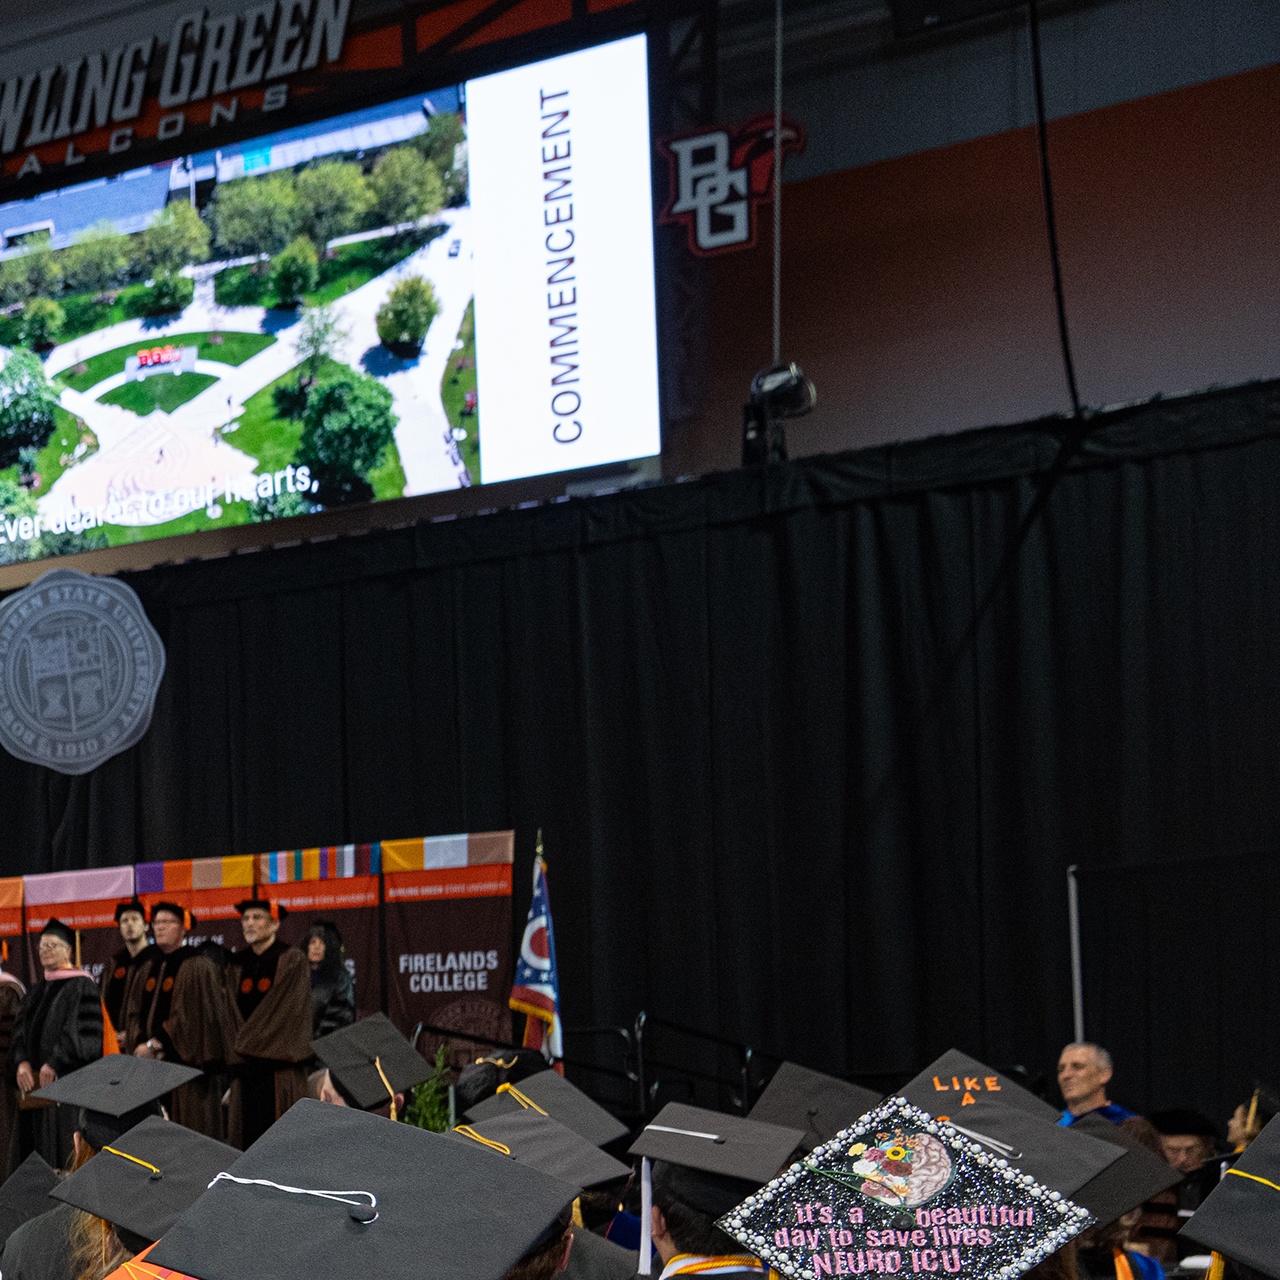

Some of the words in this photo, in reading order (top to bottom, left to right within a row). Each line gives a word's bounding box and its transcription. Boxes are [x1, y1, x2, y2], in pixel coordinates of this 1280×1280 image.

[159, 0, 354, 108] GREEN
[540, 88, 583, 443] COMMENCEMENT
[140, 489, 166, 516] to
[174, 484, 216, 511] our
[398, 951, 499, 973] FIRELANDS
[409, 971, 489, 993] COLLEGE
[932, 1076, 1001, 1092] LIKE
[961, 1091, 976, 1107] A
[795, 1202, 834, 1225] it's
[849, 1205, 865, 1225] a
[916, 1204, 1035, 1229] beautiful
[773, 1228, 821, 1250] day
[829, 1228, 853, 1247] to
[866, 1229, 928, 1247] save
[933, 1227, 994, 1247] lives
[813, 1250, 902, 1277] NEURO
[912, 1248, 962, 1274] ICU
